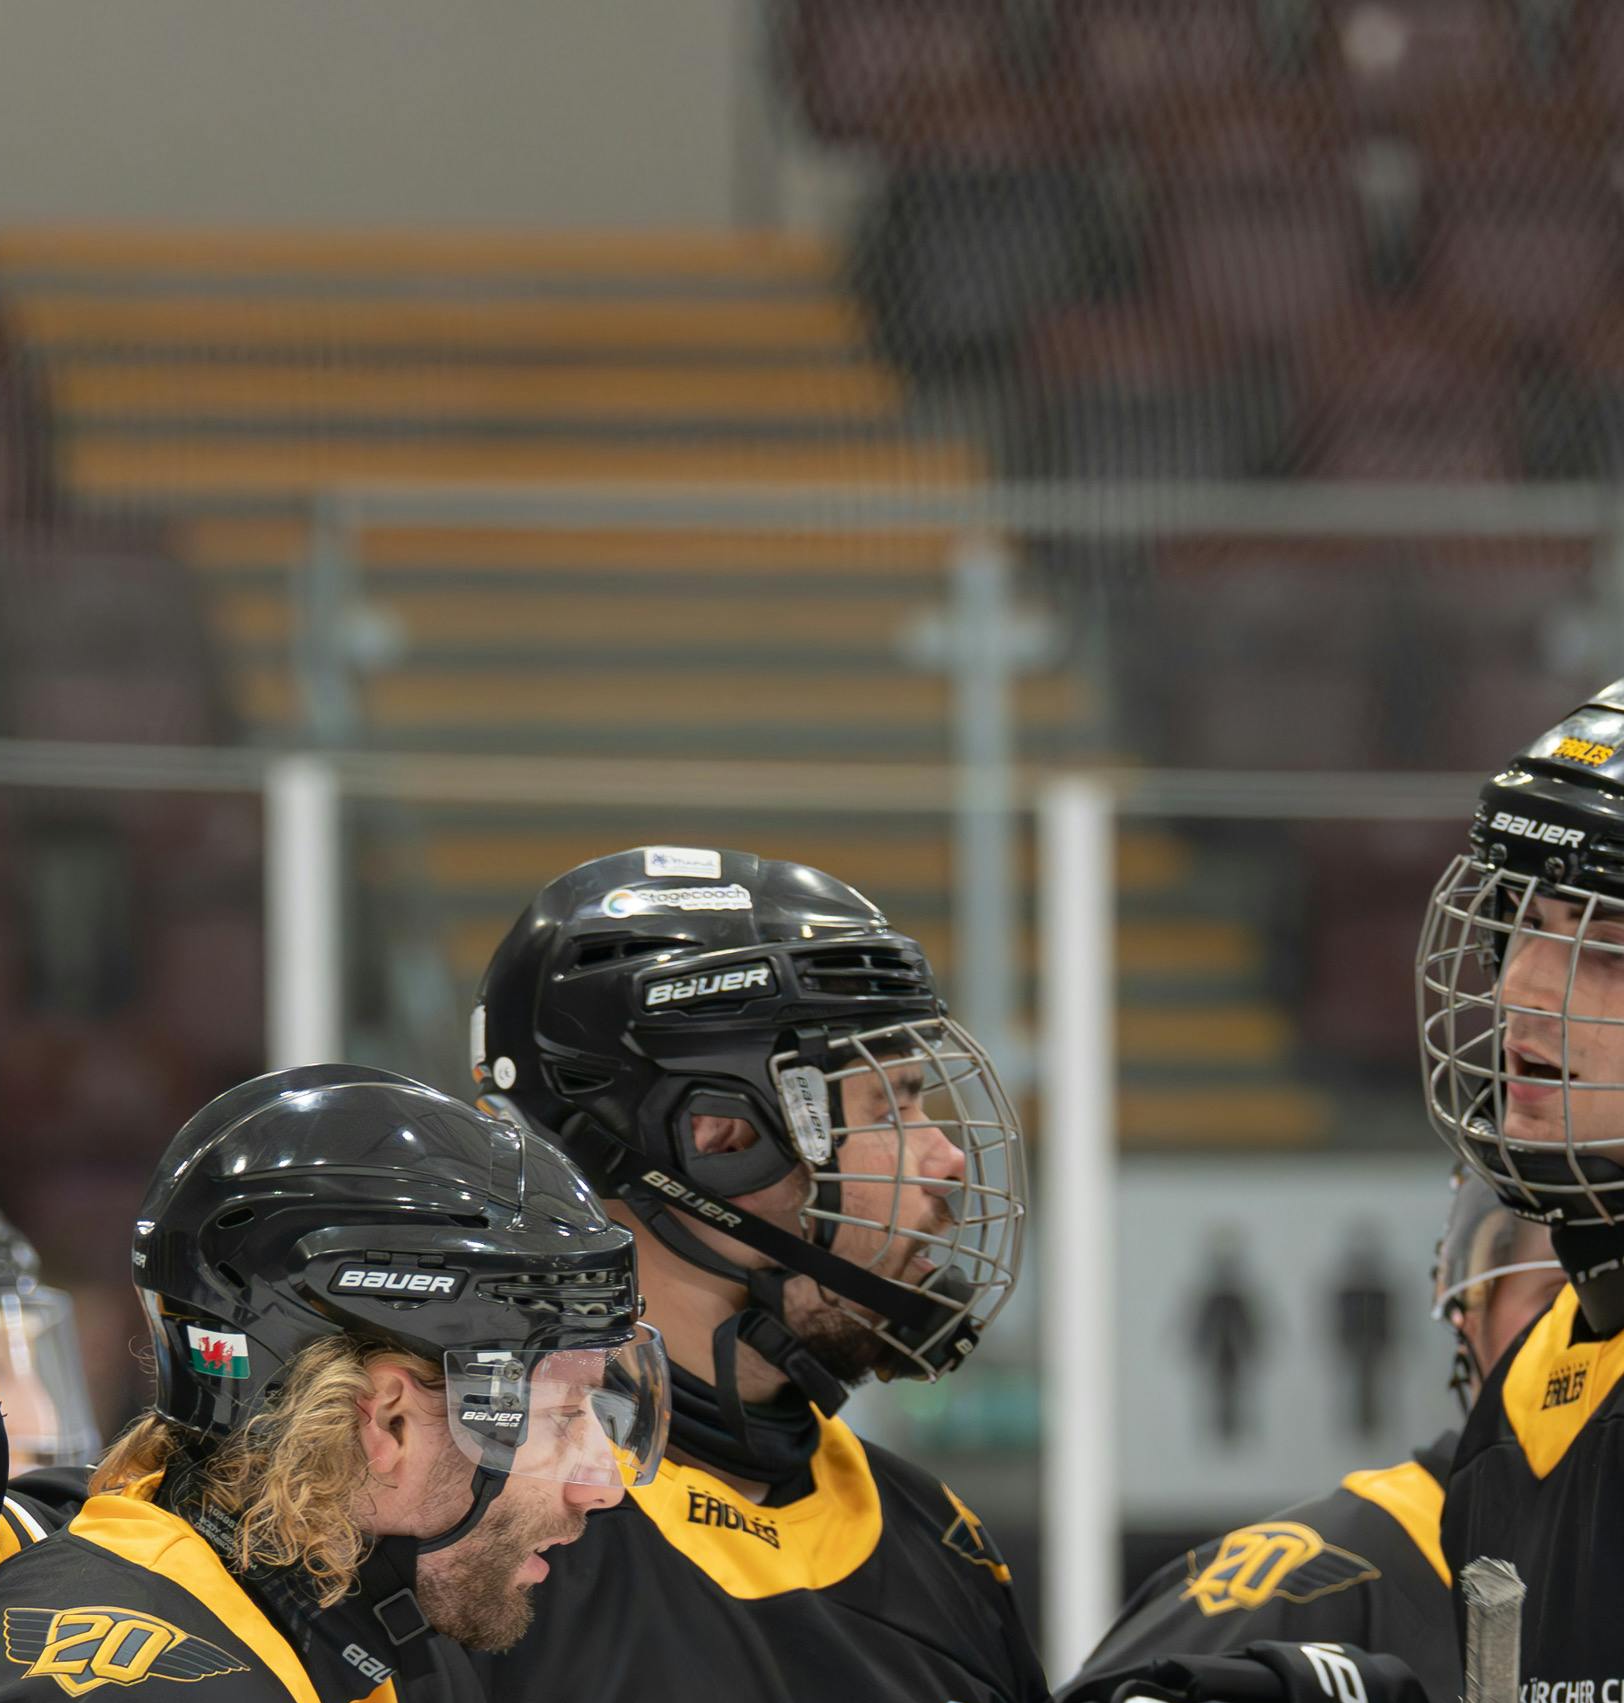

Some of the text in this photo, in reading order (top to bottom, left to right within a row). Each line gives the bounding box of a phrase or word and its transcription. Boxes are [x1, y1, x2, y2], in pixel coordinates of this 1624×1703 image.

[1490, 811, 1586, 849] BAUER
[645, 966, 770, 1007] BAUER
[640, 1168, 742, 1230] BAUER
[338, 1268, 455, 1294] BAUER
[1190, 1532, 1303, 1606] 20
[23, 1613, 177, 1682] 20
